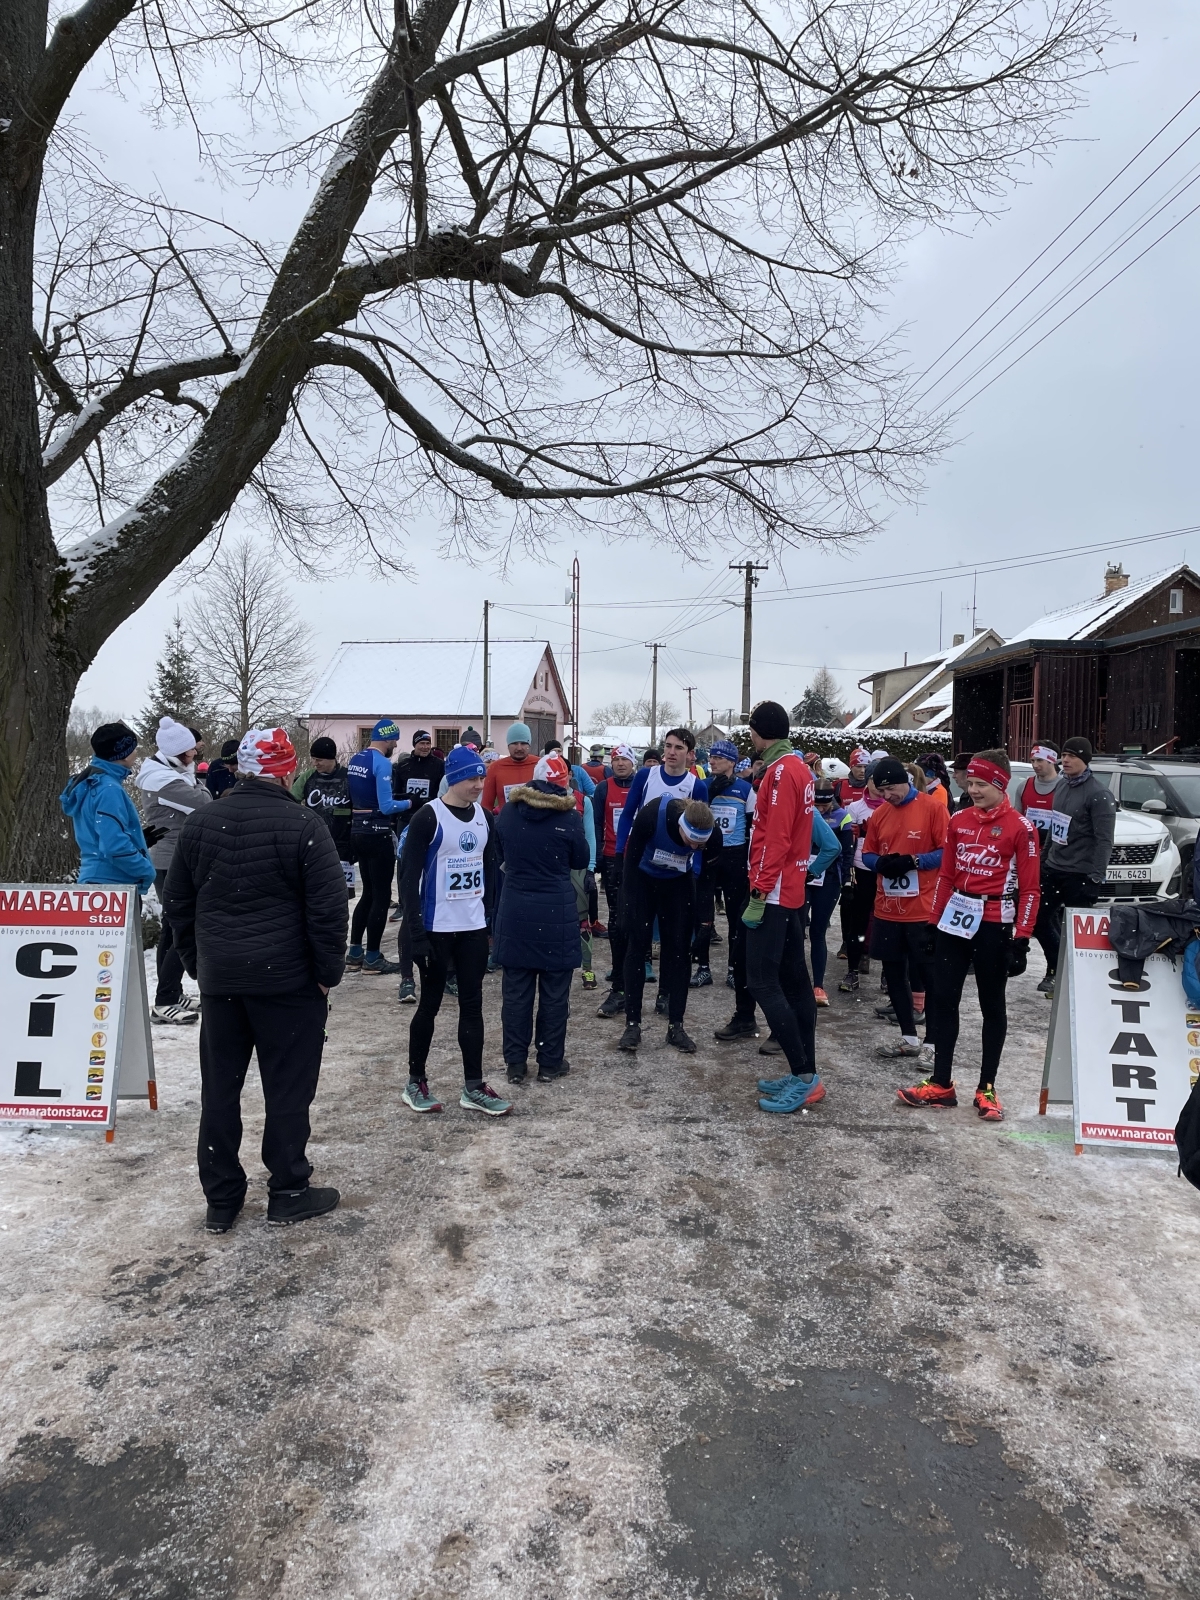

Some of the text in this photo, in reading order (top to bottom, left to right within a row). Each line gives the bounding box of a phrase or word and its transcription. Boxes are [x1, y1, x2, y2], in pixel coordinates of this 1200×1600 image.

[449, 870, 481, 891] 236
[1107, 869, 1147, 879] 7H4 6429
[0, 890, 128, 913] MARATON
[89, 913, 122, 924] stav
[949, 910, 975, 930] 50
[14, 942, 78, 1098] CÍL
[1107, 968, 1158, 1123] START
[1085, 1126, 1175, 1142] www.maraton
